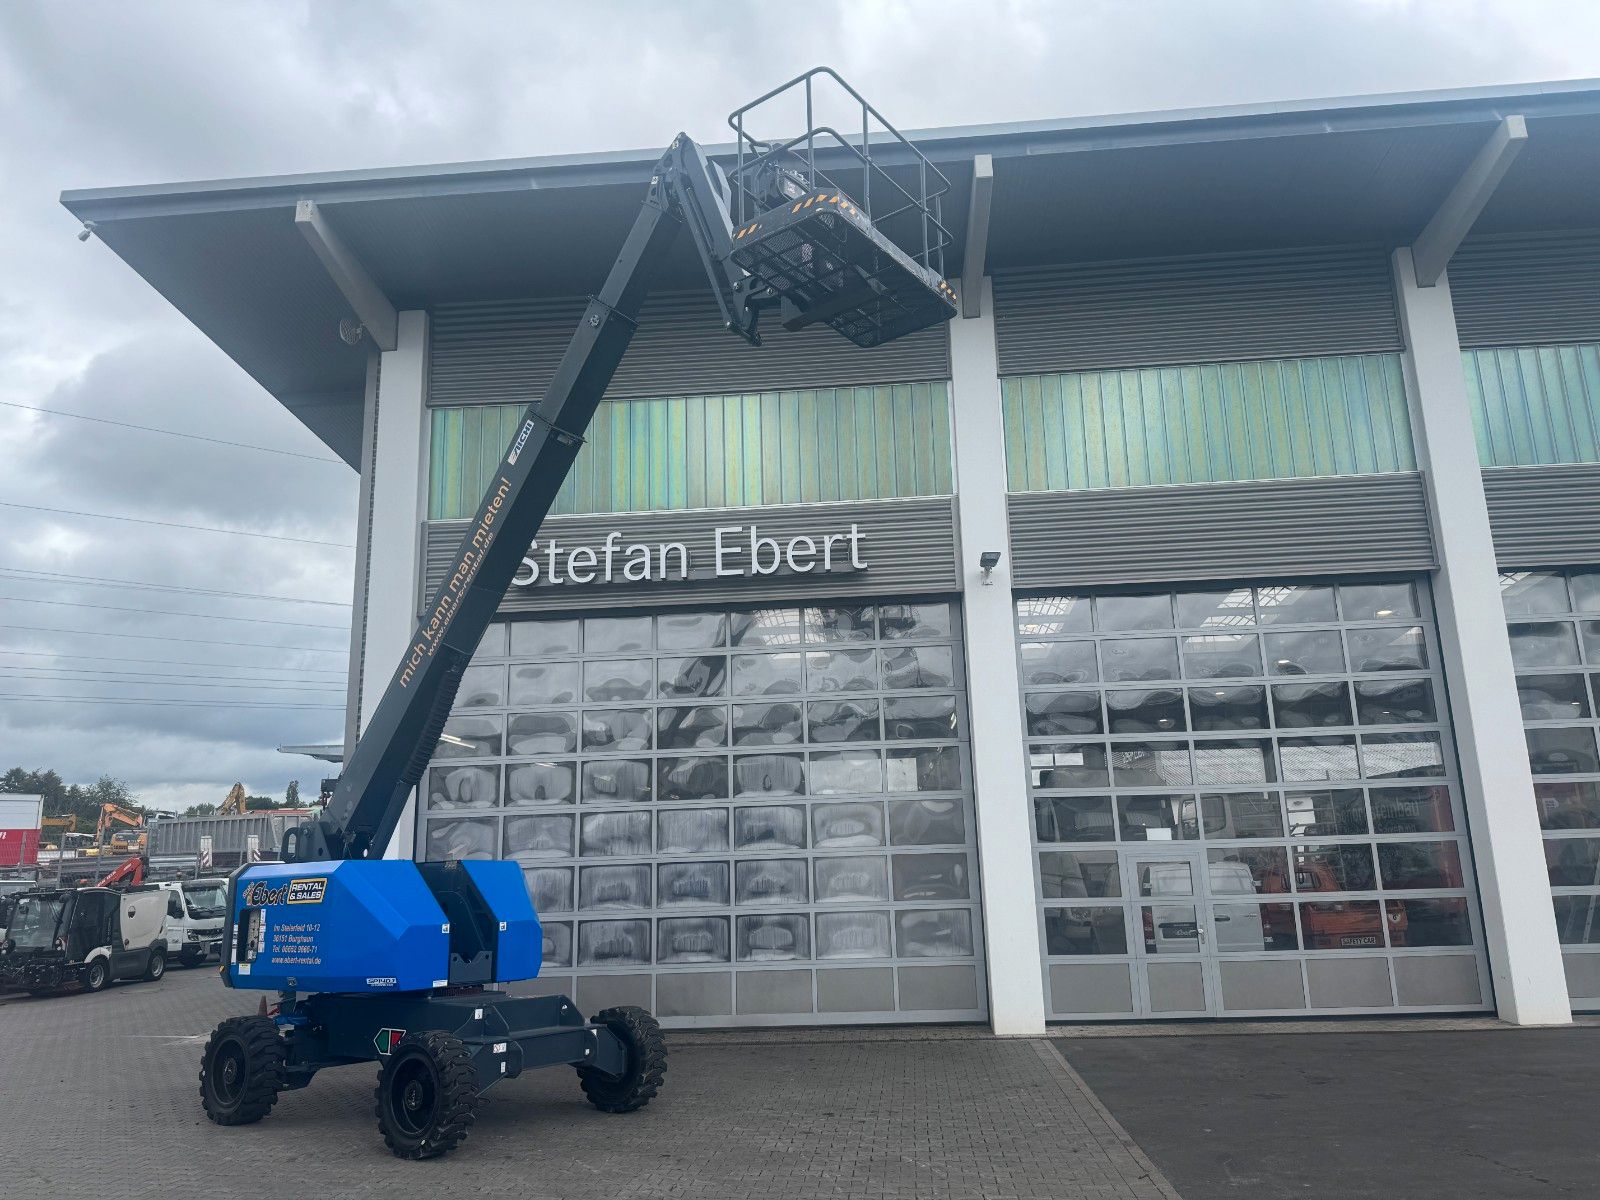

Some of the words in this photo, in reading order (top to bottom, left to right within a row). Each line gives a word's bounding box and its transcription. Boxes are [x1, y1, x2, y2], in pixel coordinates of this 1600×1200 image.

[714, 524, 868, 577] Ebert
[399, 643, 428, 688] mich
[422, 595, 452, 640] kann
[449, 551, 476, 594] man
[472, 477, 512, 551] mieten!
[252, 881, 288, 905] Ebert
[289, 892, 296, 900] &
[296, 891, 321, 900] SALES
[292, 882, 323, 892] RENTAL
[1363, 936, 1375, 944] CAR
